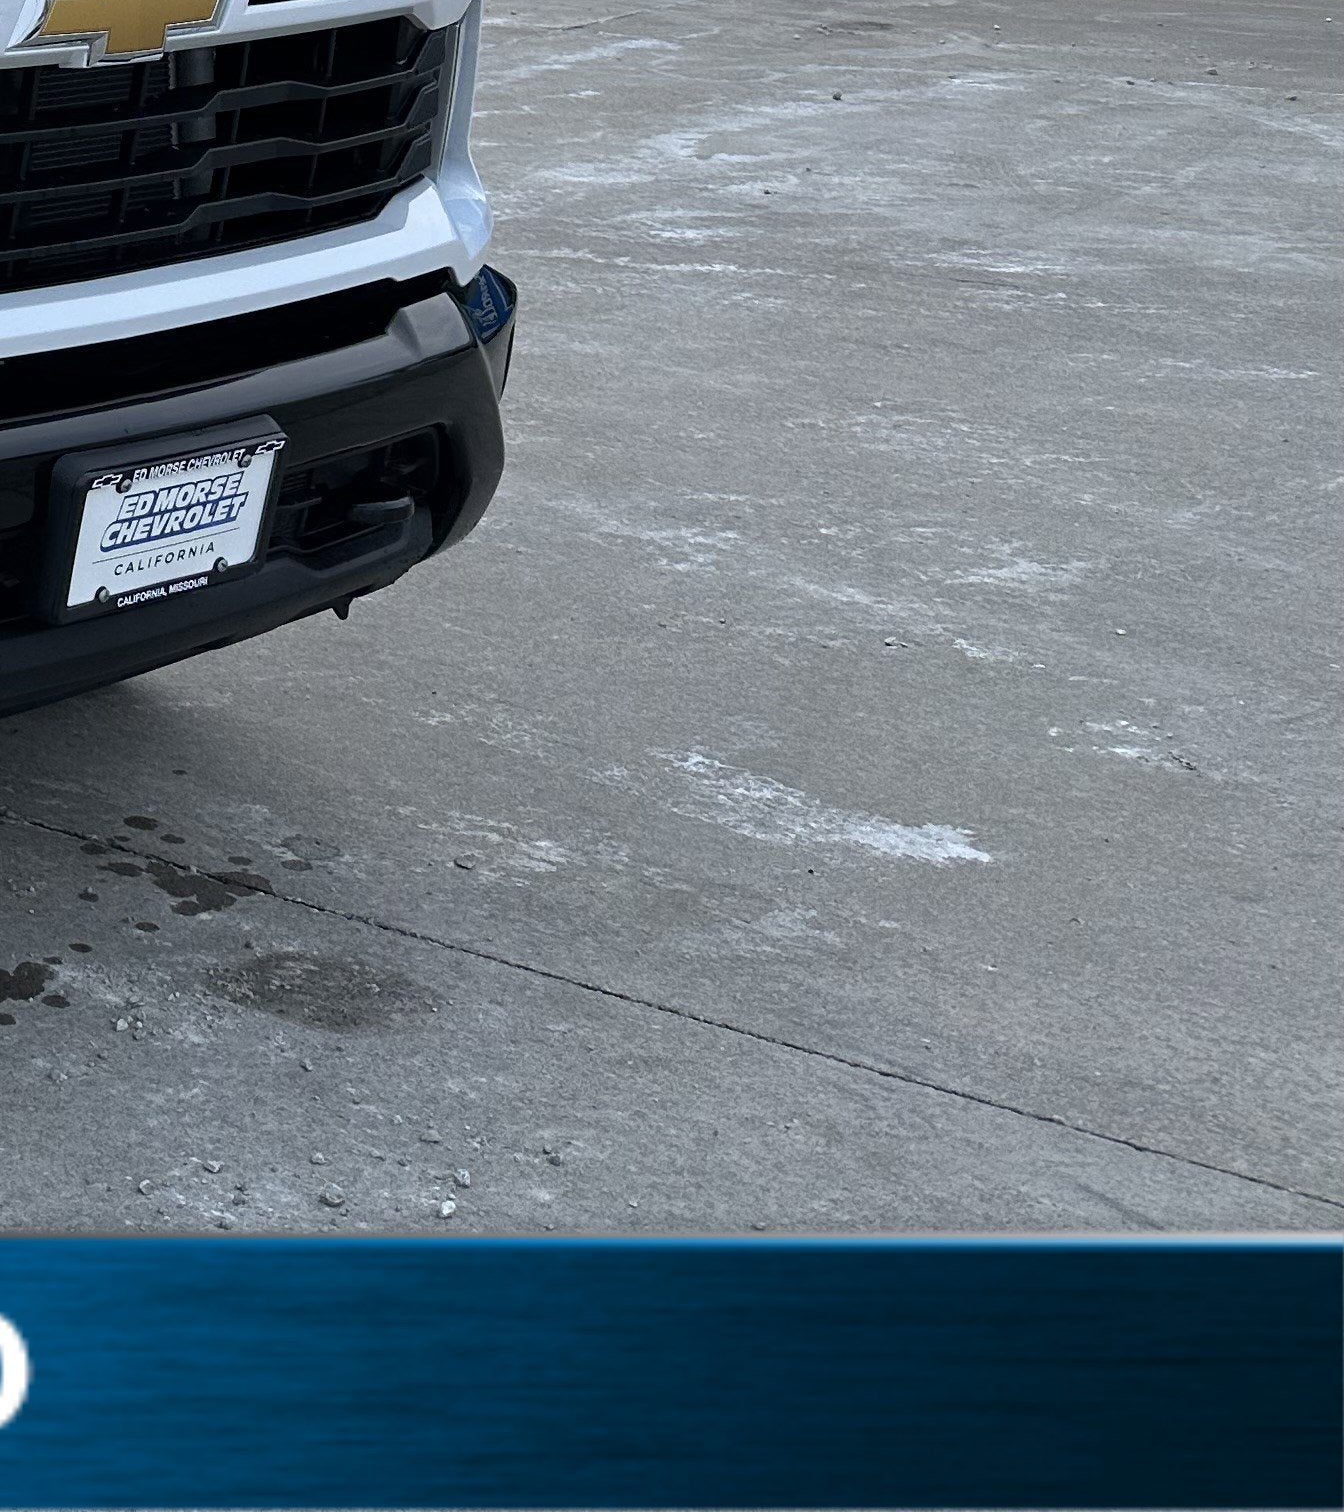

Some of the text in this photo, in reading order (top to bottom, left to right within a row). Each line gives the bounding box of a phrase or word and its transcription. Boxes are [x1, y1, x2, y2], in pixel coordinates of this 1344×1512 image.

[132, 448, 246, 483] ED MORSE CHEVROLET
[117, 471, 244, 522] ED MORSE
[99, 491, 249, 553] CHEVROLET
[113, 541, 215, 576] CALIFORNIA
[168, 576, 209, 594] MISSOURI
